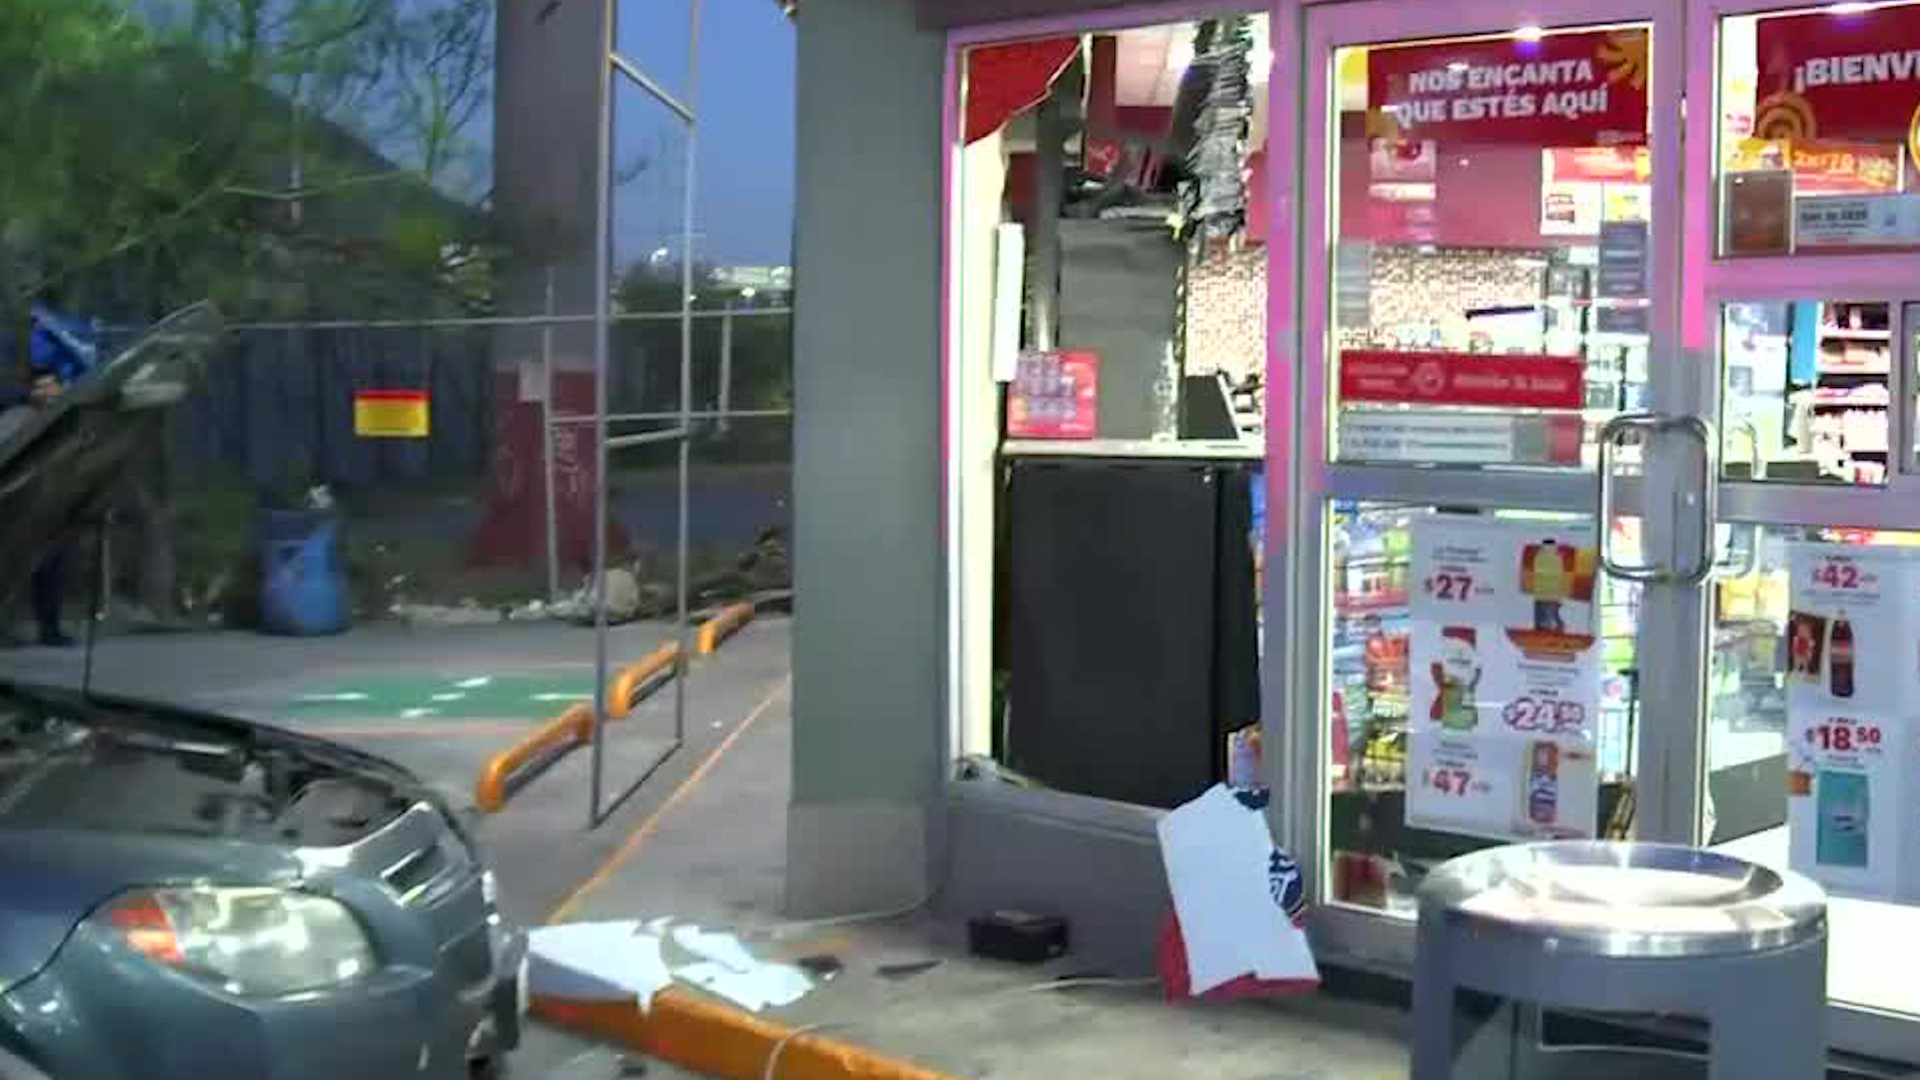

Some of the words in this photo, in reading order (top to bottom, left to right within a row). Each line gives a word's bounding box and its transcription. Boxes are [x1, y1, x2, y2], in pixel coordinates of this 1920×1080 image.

[1409, 66, 1463, 94] NOS
[1467, 59, 1593, 89] ENCANTA
[1396, 98, 1446, 128] QUE
[1452, 89, 1537, 120] ESTÉS
[1541, 82, 1608, 119] AQUÍ
